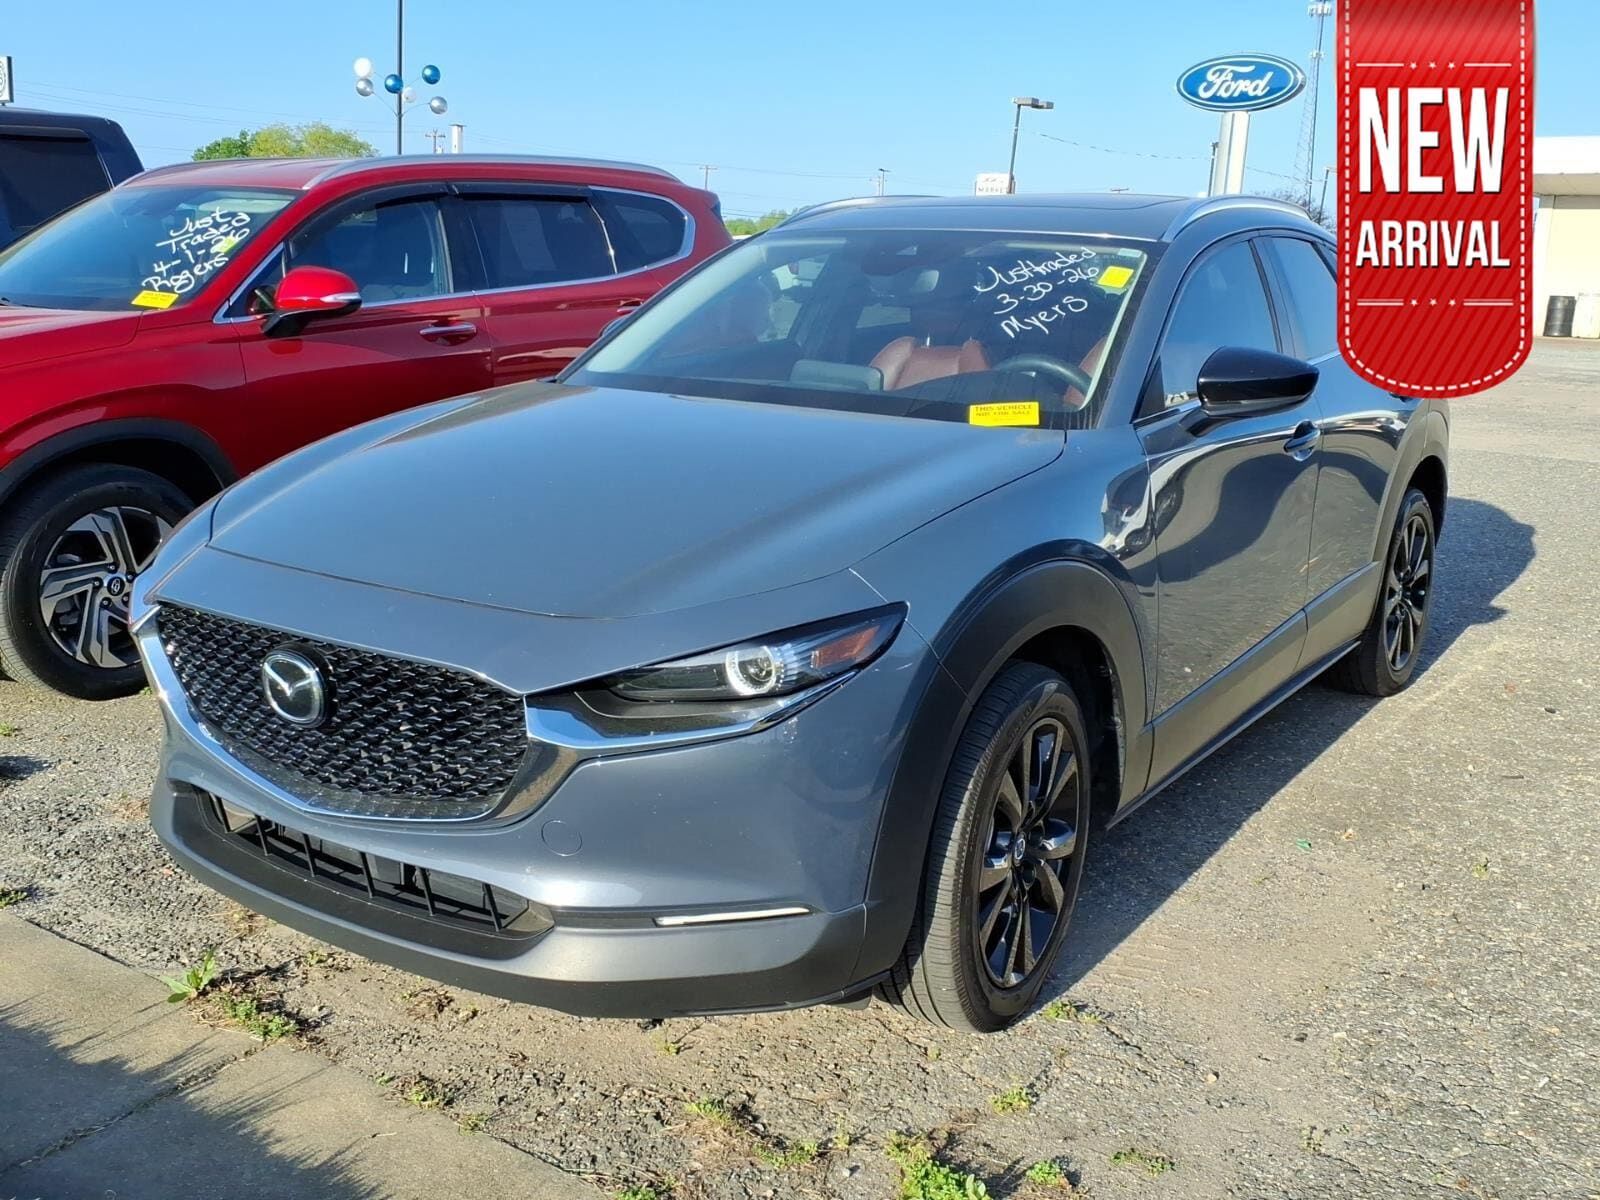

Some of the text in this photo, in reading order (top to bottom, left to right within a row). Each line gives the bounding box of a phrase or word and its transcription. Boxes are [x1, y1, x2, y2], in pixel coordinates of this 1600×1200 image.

[1198, 65, 1274, 99] Ford
[155, 212, 251, 254] Traded
[169, 206, 232, 236] Just
[993, 267, 1099, 315] 3-30-26
[1001, 296, 1088, 338] Myers
